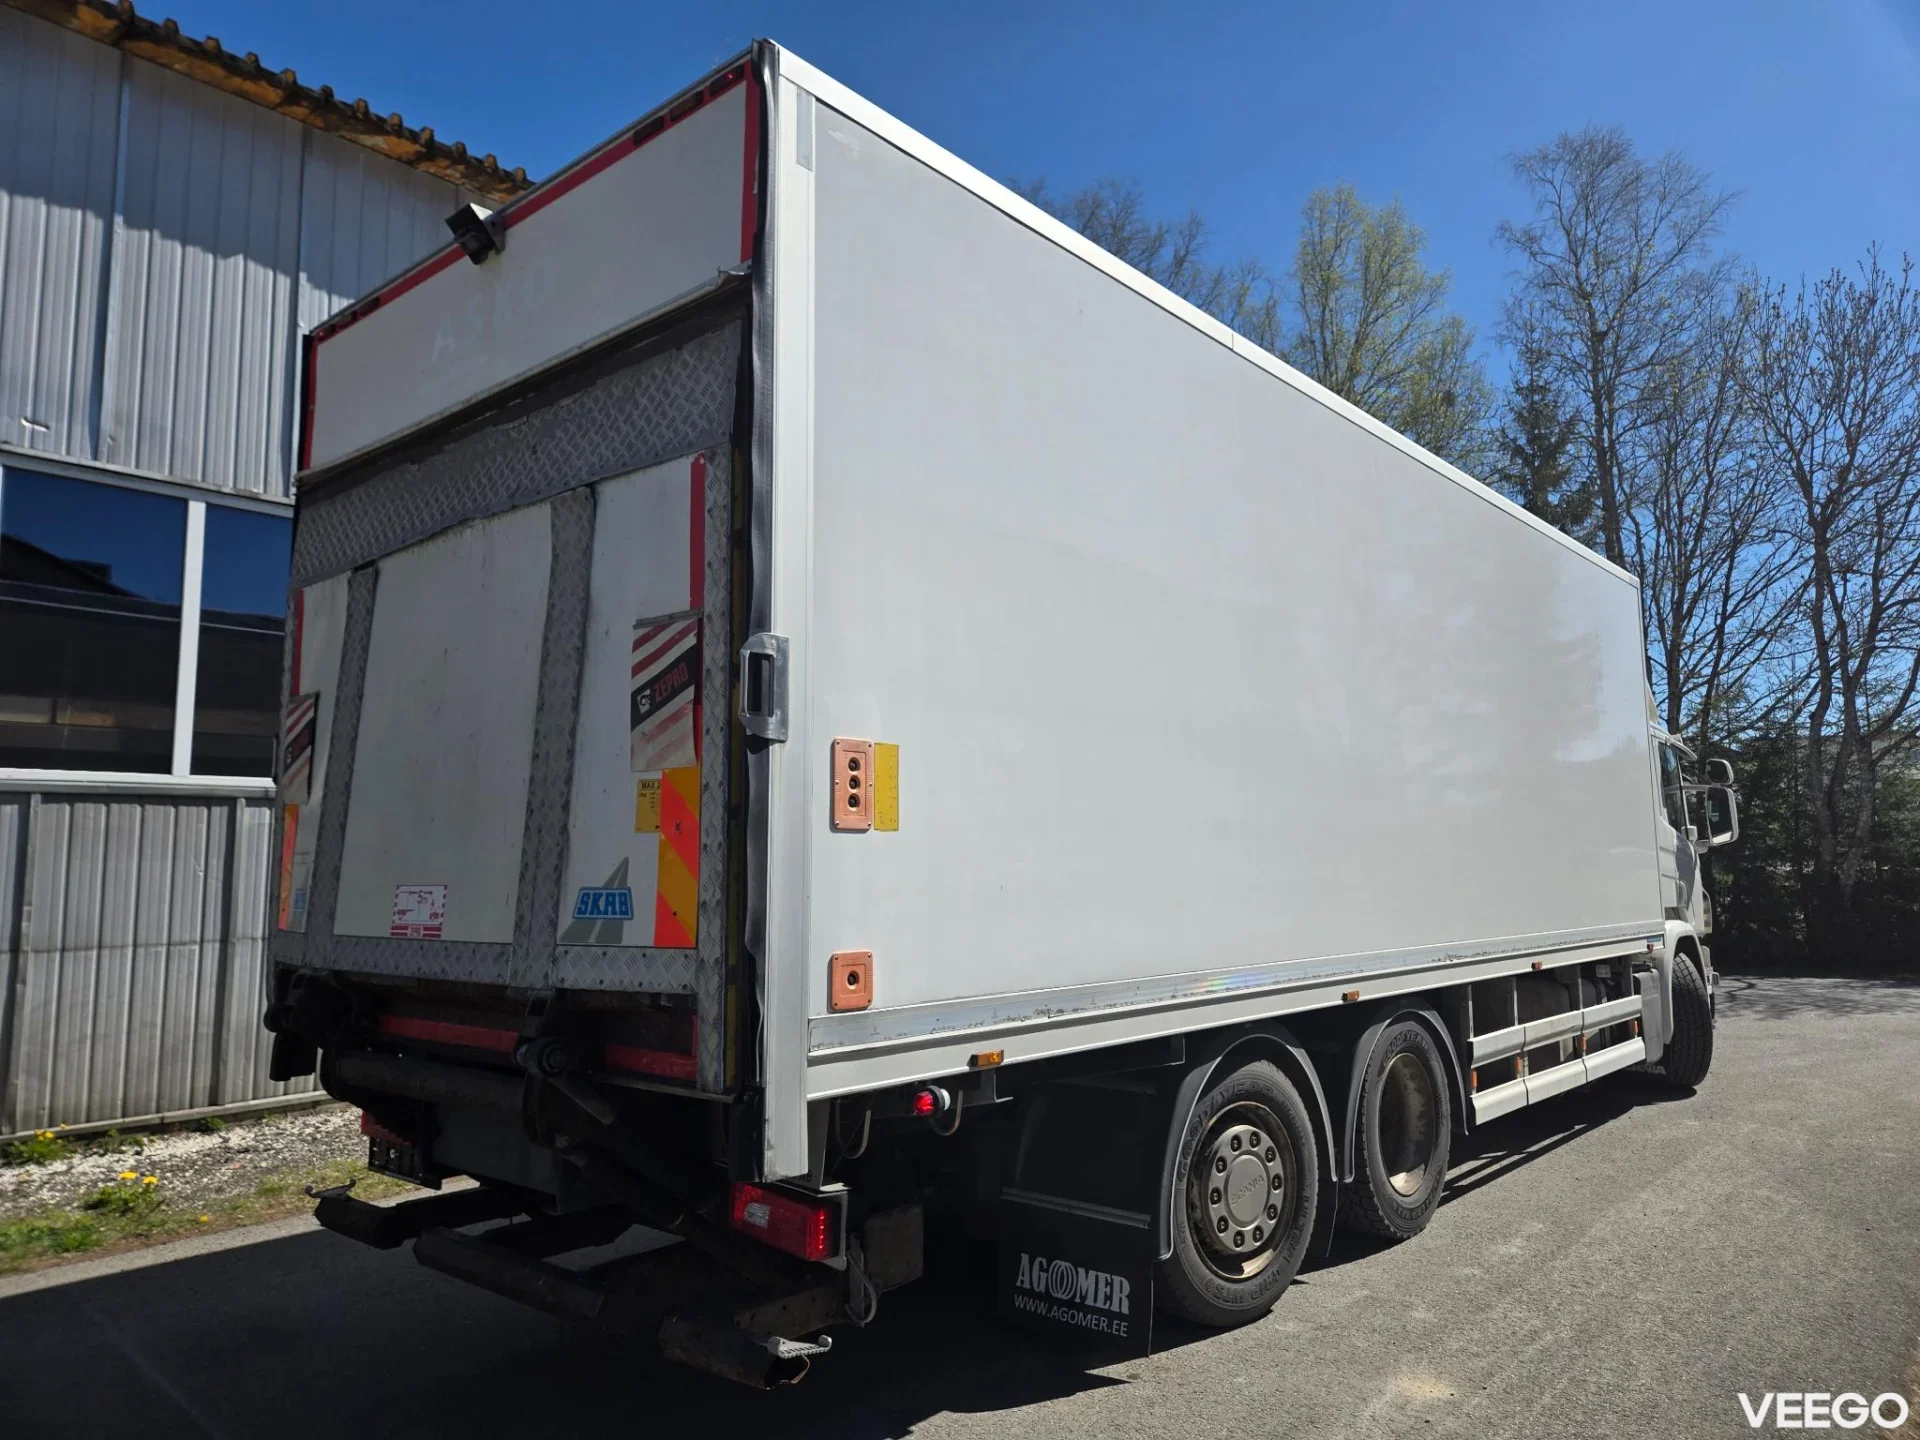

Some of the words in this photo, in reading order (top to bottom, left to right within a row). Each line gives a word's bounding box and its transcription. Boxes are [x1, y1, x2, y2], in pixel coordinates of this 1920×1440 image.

[651, 662, 689, 703] ZEPRO
[641, 780, 656, 790] MAX
[576, 892, 631, 916] SKAB
[1230, 1173, 1266, 1206] SCANIA
[1015, 1253, 1131, 1314] AGOMER
[1014, 1294, 1129, 1337] WWW.AGOMER.EE
